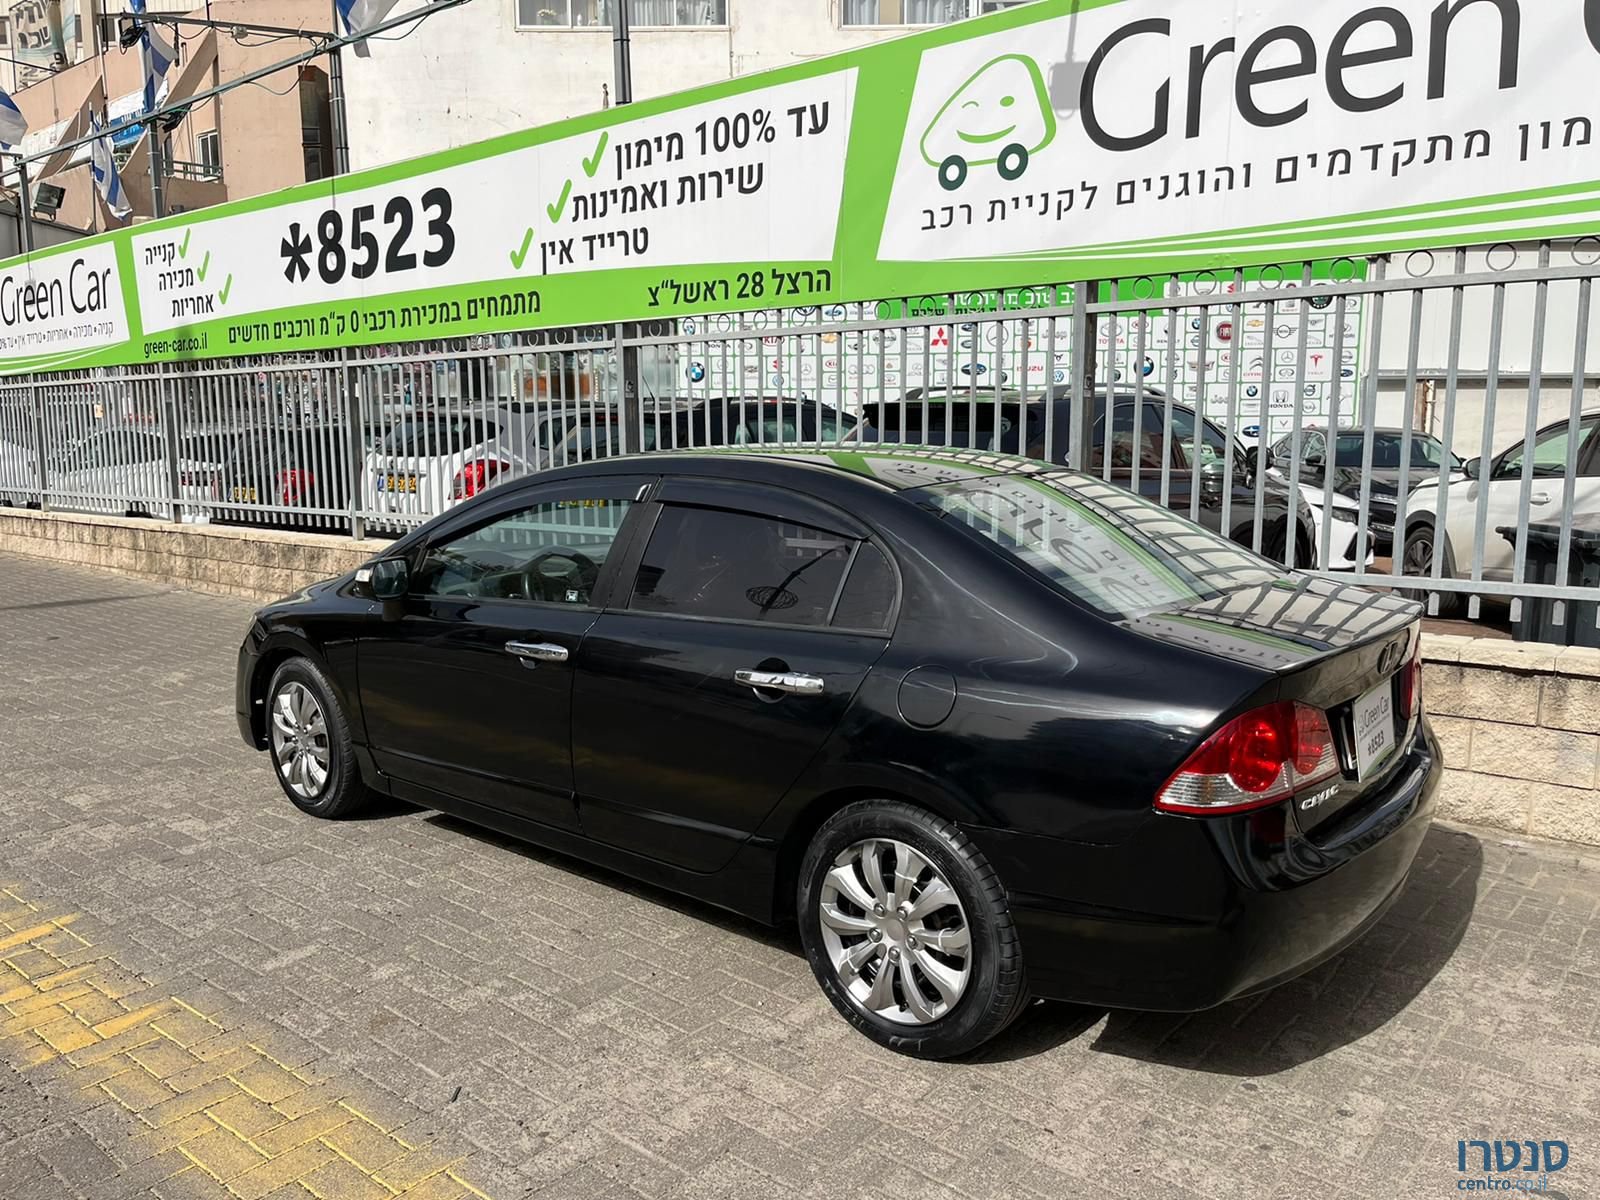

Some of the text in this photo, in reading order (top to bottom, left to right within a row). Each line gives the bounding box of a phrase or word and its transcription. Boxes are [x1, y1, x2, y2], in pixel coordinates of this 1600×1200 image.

[1080, 0, 1521, 151] Green
[615, 101, 829, 181] עד 100% מימון
[921, 116, 1592, 231] מון מתקדמים והוגנים לקניית רכב
[572, 162, 764, 222] שירות ואמינות
[145, 242, 175, 267] קנייה
[540, 227, 649, 275] טרייד אין
[1, 258, 111, 326] Green Car
[158, 267, 194, 291] מכירה
[737, 271, 764, 299] 28
[771, 268, 831, 296] הרצל
[171, 293, 214, 318] אחריות
[400, 302, 462, 332] במכירת
[467, 290, 541, 321] מתמחים
[228, 324, 270, 344] חדשים
[273, 319, 315, 340] ורכבים
[351, 310, 360, 333] 0
[362, 312, 396, 333] רכבי
[144, 332, 208, 358] green-car.co.il
[1301, 784, 1340, 810] CIVIC
